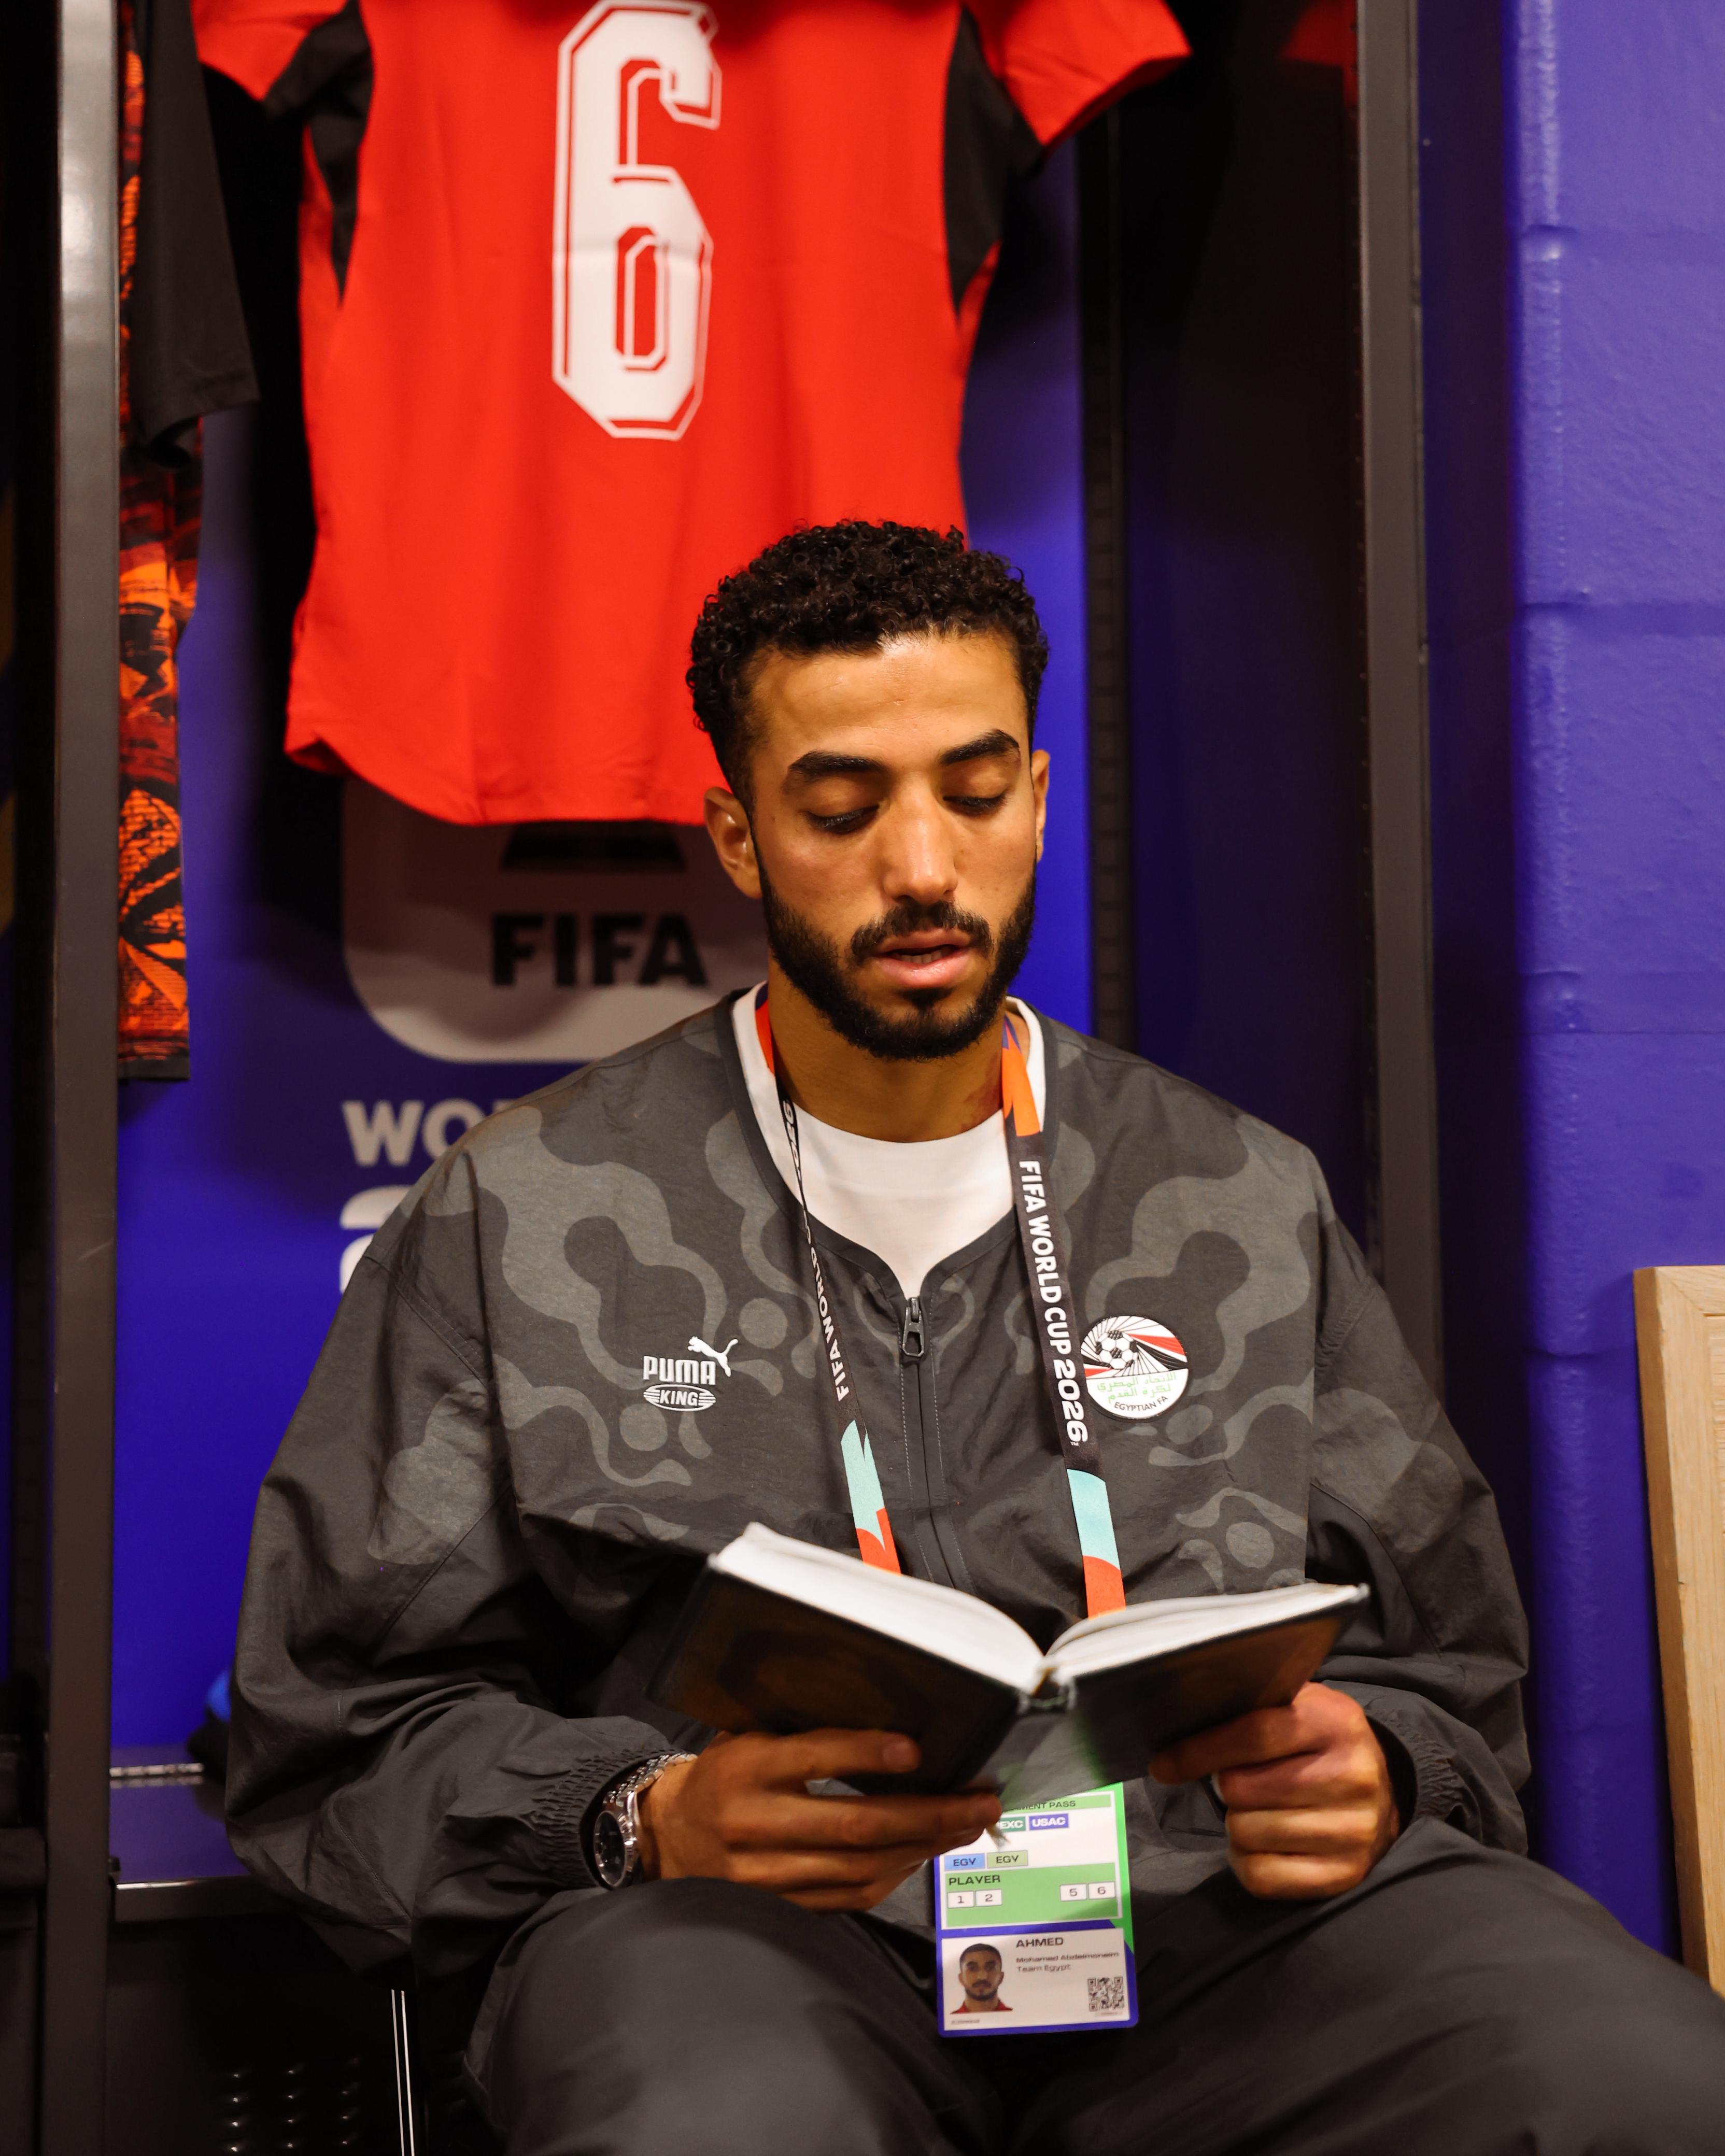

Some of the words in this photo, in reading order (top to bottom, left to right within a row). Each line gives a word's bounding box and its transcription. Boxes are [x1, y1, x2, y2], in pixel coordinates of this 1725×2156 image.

[552, 0, 722, 441] 6
[492, 913, 709, 986] FIFA
[342, 1099, 518, 1167] WO
[1019, 1161, 1047, 1213] FIFA
[1028, 1215, 1062, 1303] WORLD
[811, 1247, 834, 1343] WORLD
[1044, 1307, 1071, 1355] CUP
[643, 1356, 716, 1385] PUMA
[830, 1339, 849, 1401] FIFA
[660, 1390, 699, 1406] KING
[1053, 1359, 1088, 1442] 2026
[1114, 1401, 1156, 1411] EGYPTIAN
[1157, 1396, 1168, 1405] FA
[1032, 1817, 1066, 1827] USAC
[949, 1875, 1000, 1885] PLAYER
[985, 1894, 993, 1902] 2
[1069, 1888, 1078, 1897] 5
[1097, 1887, 1106, 1895] 6
[1016, 1937, 1064, 1948] AHMED
[1044, 1964, 1071, 1973] Egypt
